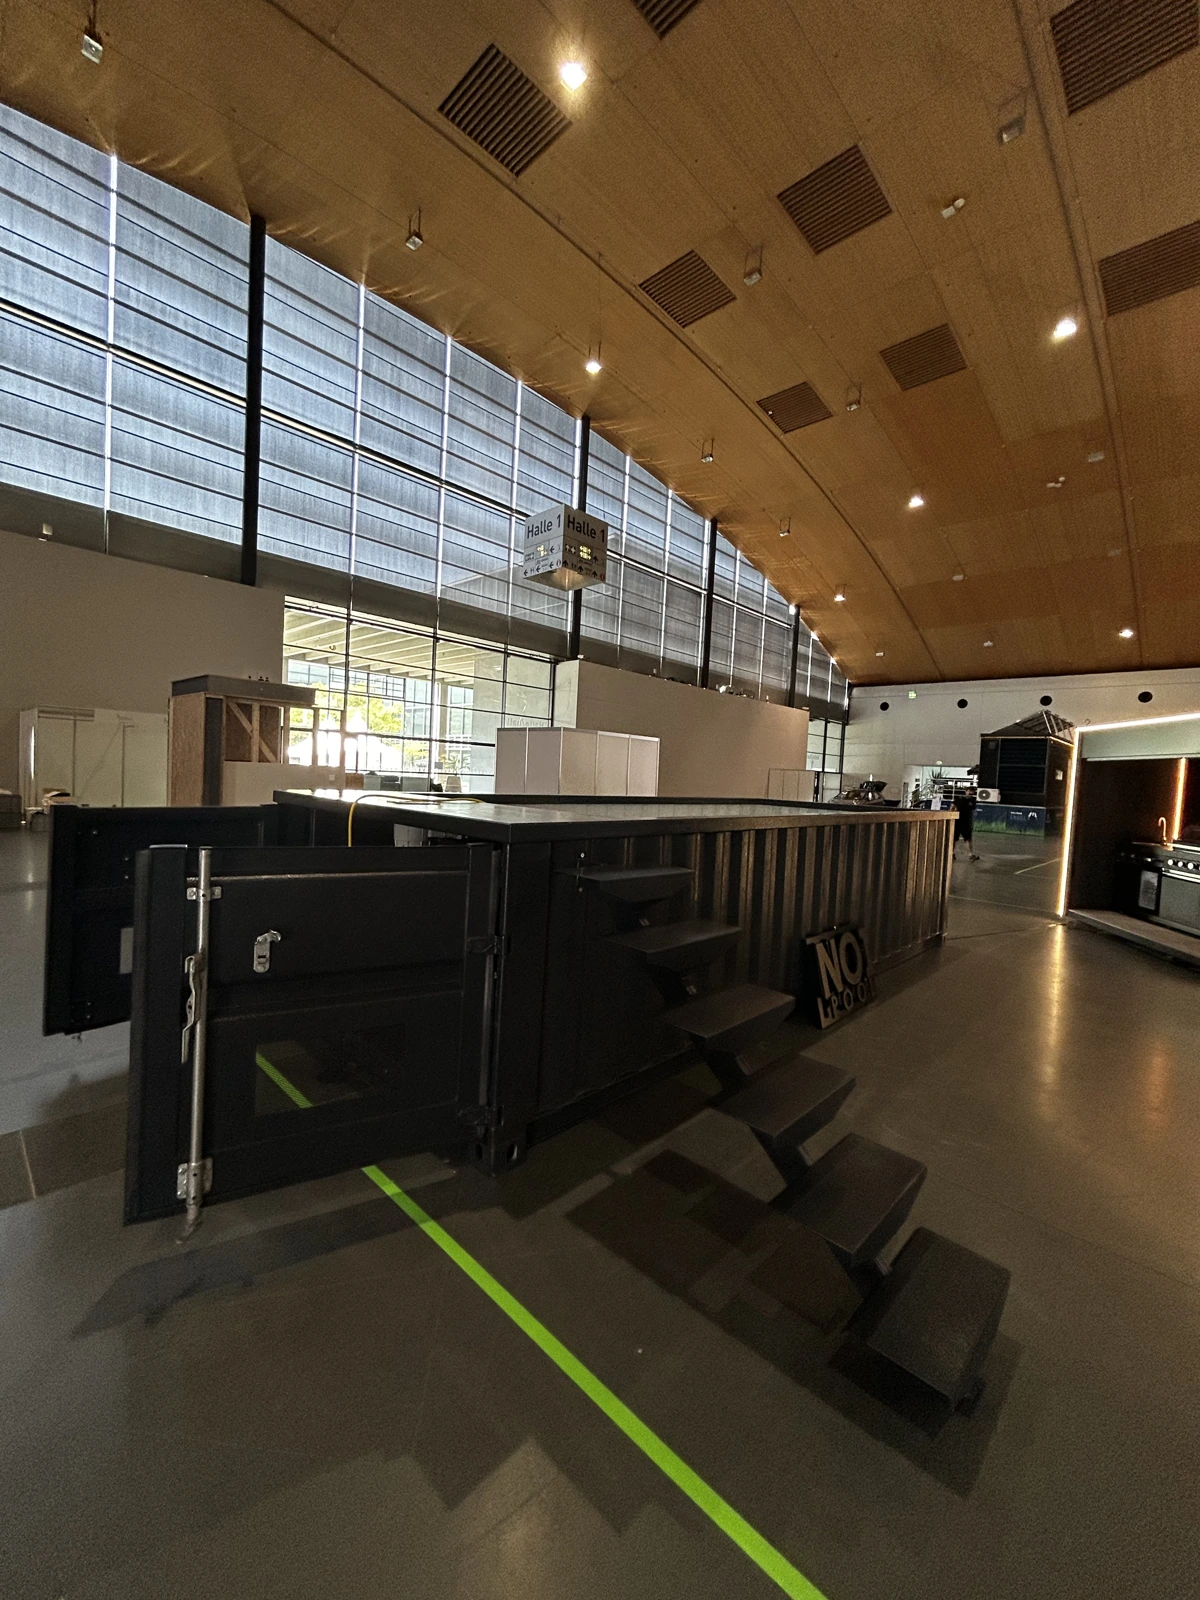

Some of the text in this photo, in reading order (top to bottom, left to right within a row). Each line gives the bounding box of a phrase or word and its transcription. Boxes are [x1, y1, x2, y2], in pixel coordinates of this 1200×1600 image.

[527, 514, 562, 539] Halle 1
[567, 514, 605, 543] Halle 1
[815, 931, 863, 1000] NO
